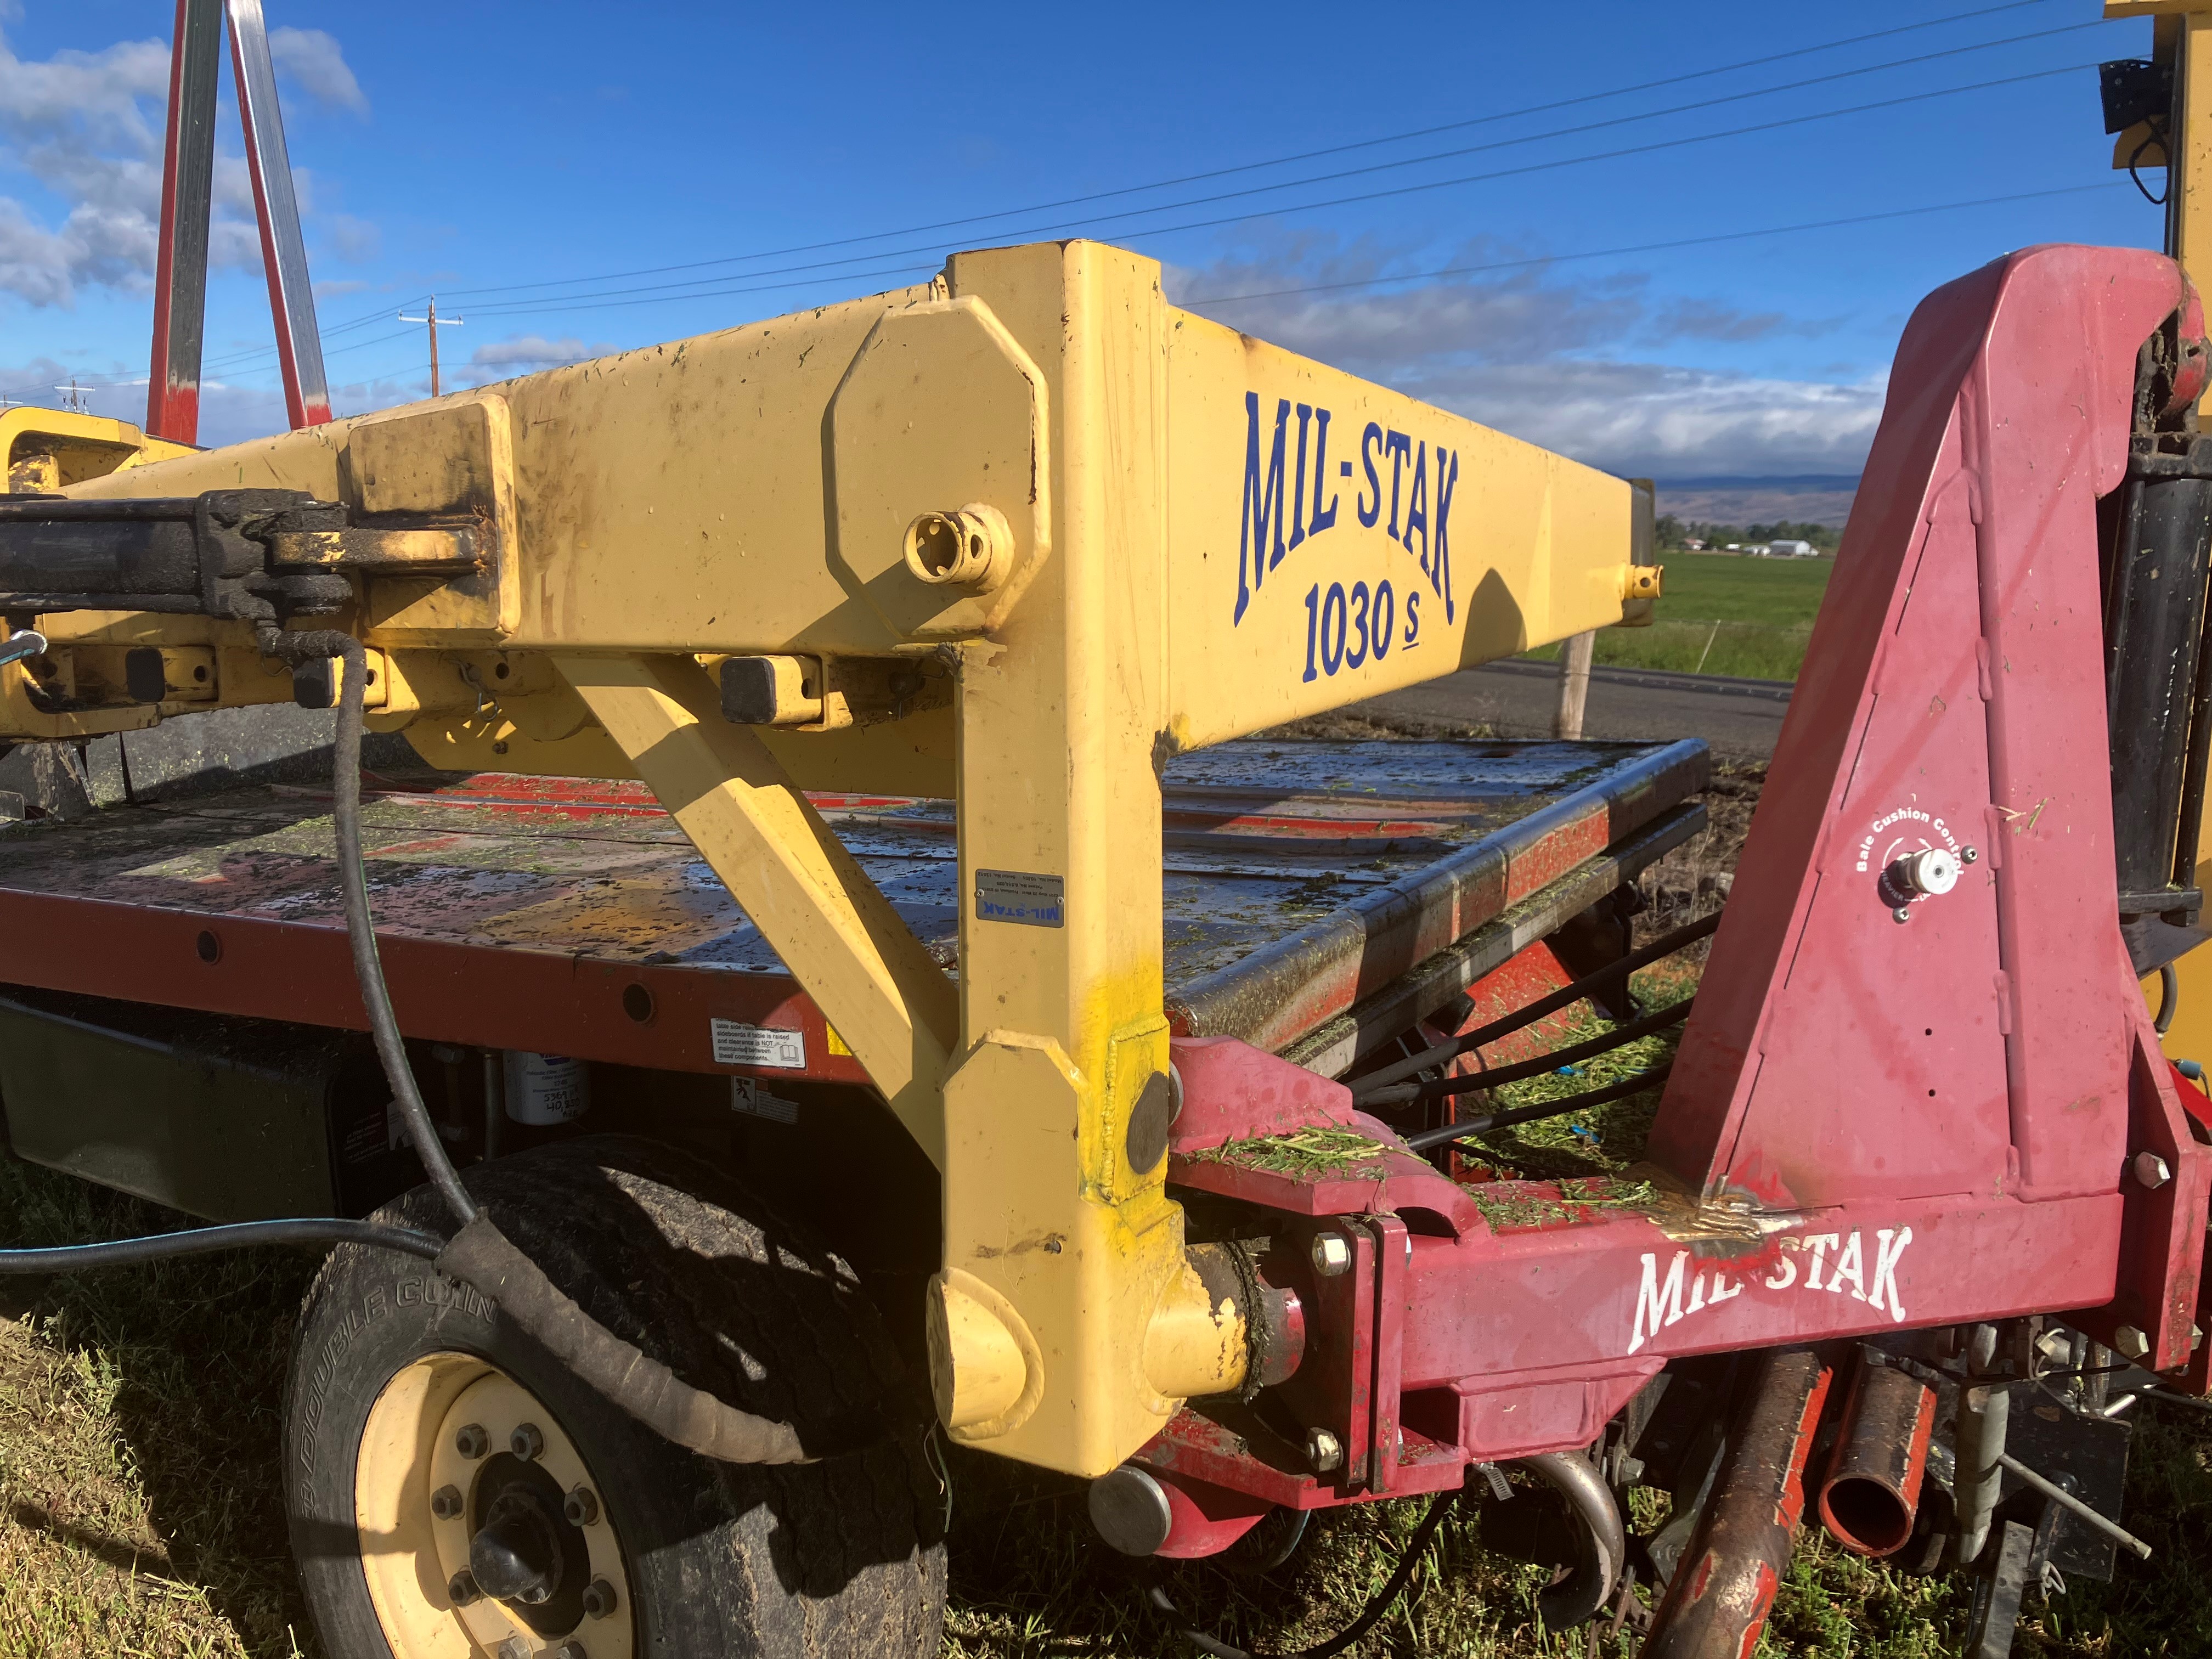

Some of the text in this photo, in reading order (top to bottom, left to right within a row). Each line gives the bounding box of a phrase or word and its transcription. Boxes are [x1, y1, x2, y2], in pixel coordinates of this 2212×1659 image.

[1234, 391, 1458, 628] MIL-STAK
[1302, 579, 1395, 683] 1030
[1857, 806, 1965, 875] Bale Cushion Control
[983, 901, 1059, 921] MIL-STAK
[718, 1046, 747, 1054] maintained
[1627, 1226, 1913, 1356] MILSTAK
[300, 1277, 499, 1476] DOUBLE COIN
